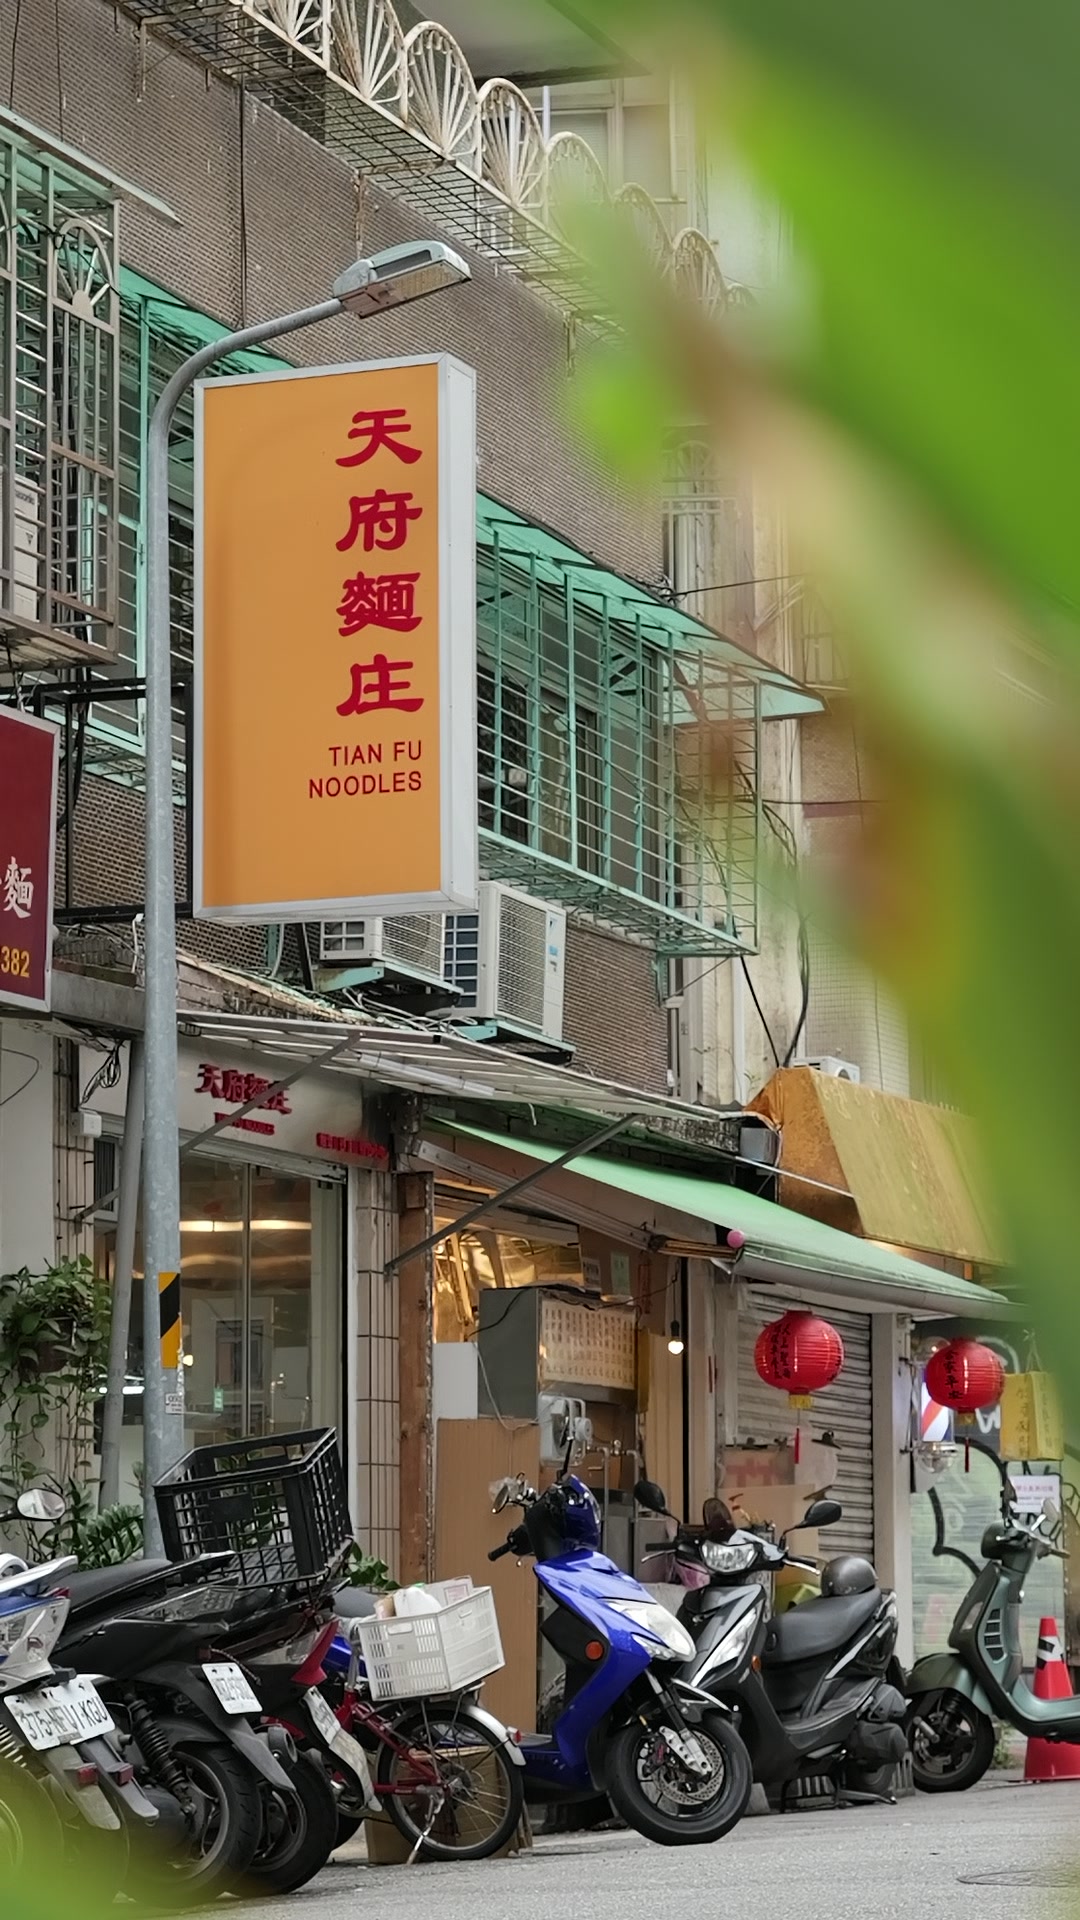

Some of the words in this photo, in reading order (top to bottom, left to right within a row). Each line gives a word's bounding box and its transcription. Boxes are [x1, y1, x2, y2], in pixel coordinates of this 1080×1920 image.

[335, 408, 425, 717] 天府麵庄
[328, 743, 382, 767] TIAN
[393, 740, 421, 762] FU
[308, 770, 421, 799] NOODLES
[0, 855, 34, 919] 麵
